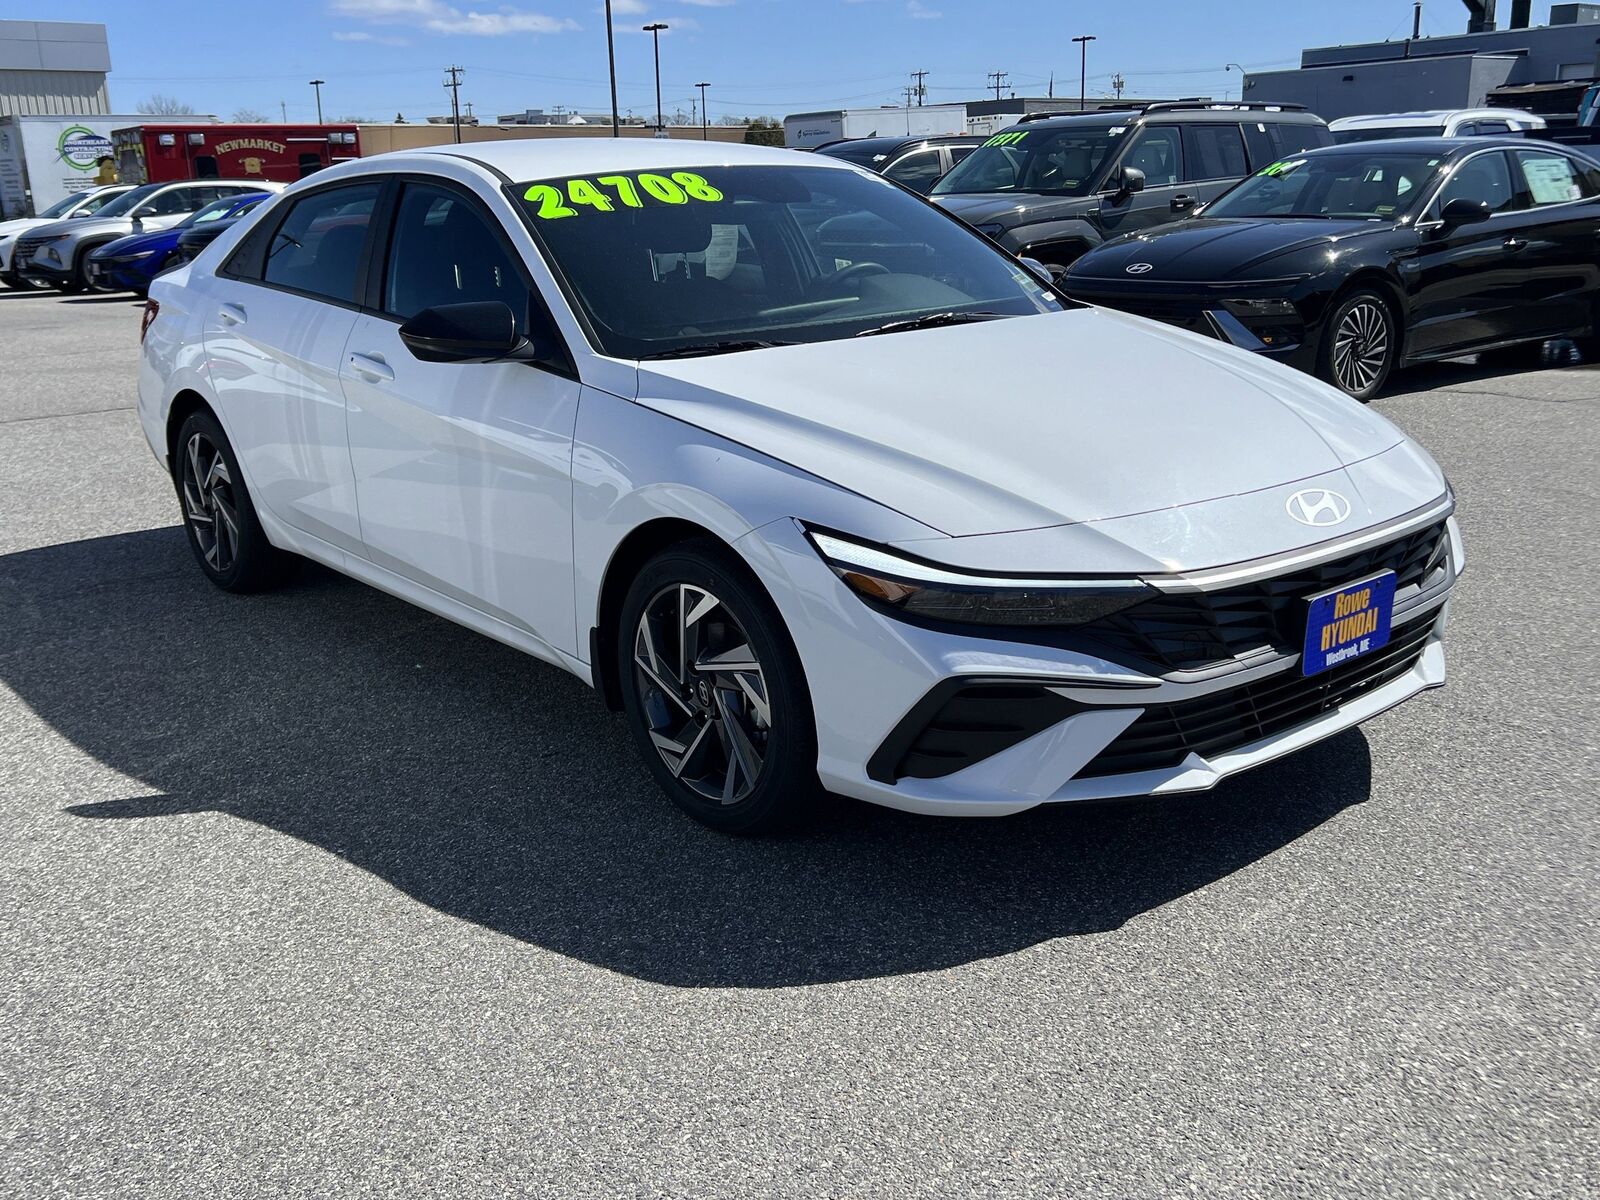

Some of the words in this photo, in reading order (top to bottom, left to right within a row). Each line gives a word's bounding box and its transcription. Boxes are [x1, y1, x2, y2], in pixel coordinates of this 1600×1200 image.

[214, 138, 287, 155] NEWMARKET
[523, 172, 724, 219] 24708
[1334, 588, 1371, 620] Rowe
[1321, 607, 1379, 651] HYUNDAI
[1326, 643, 1359, 666] Westbrook,
[1360, 637, 1371, 653] ME
